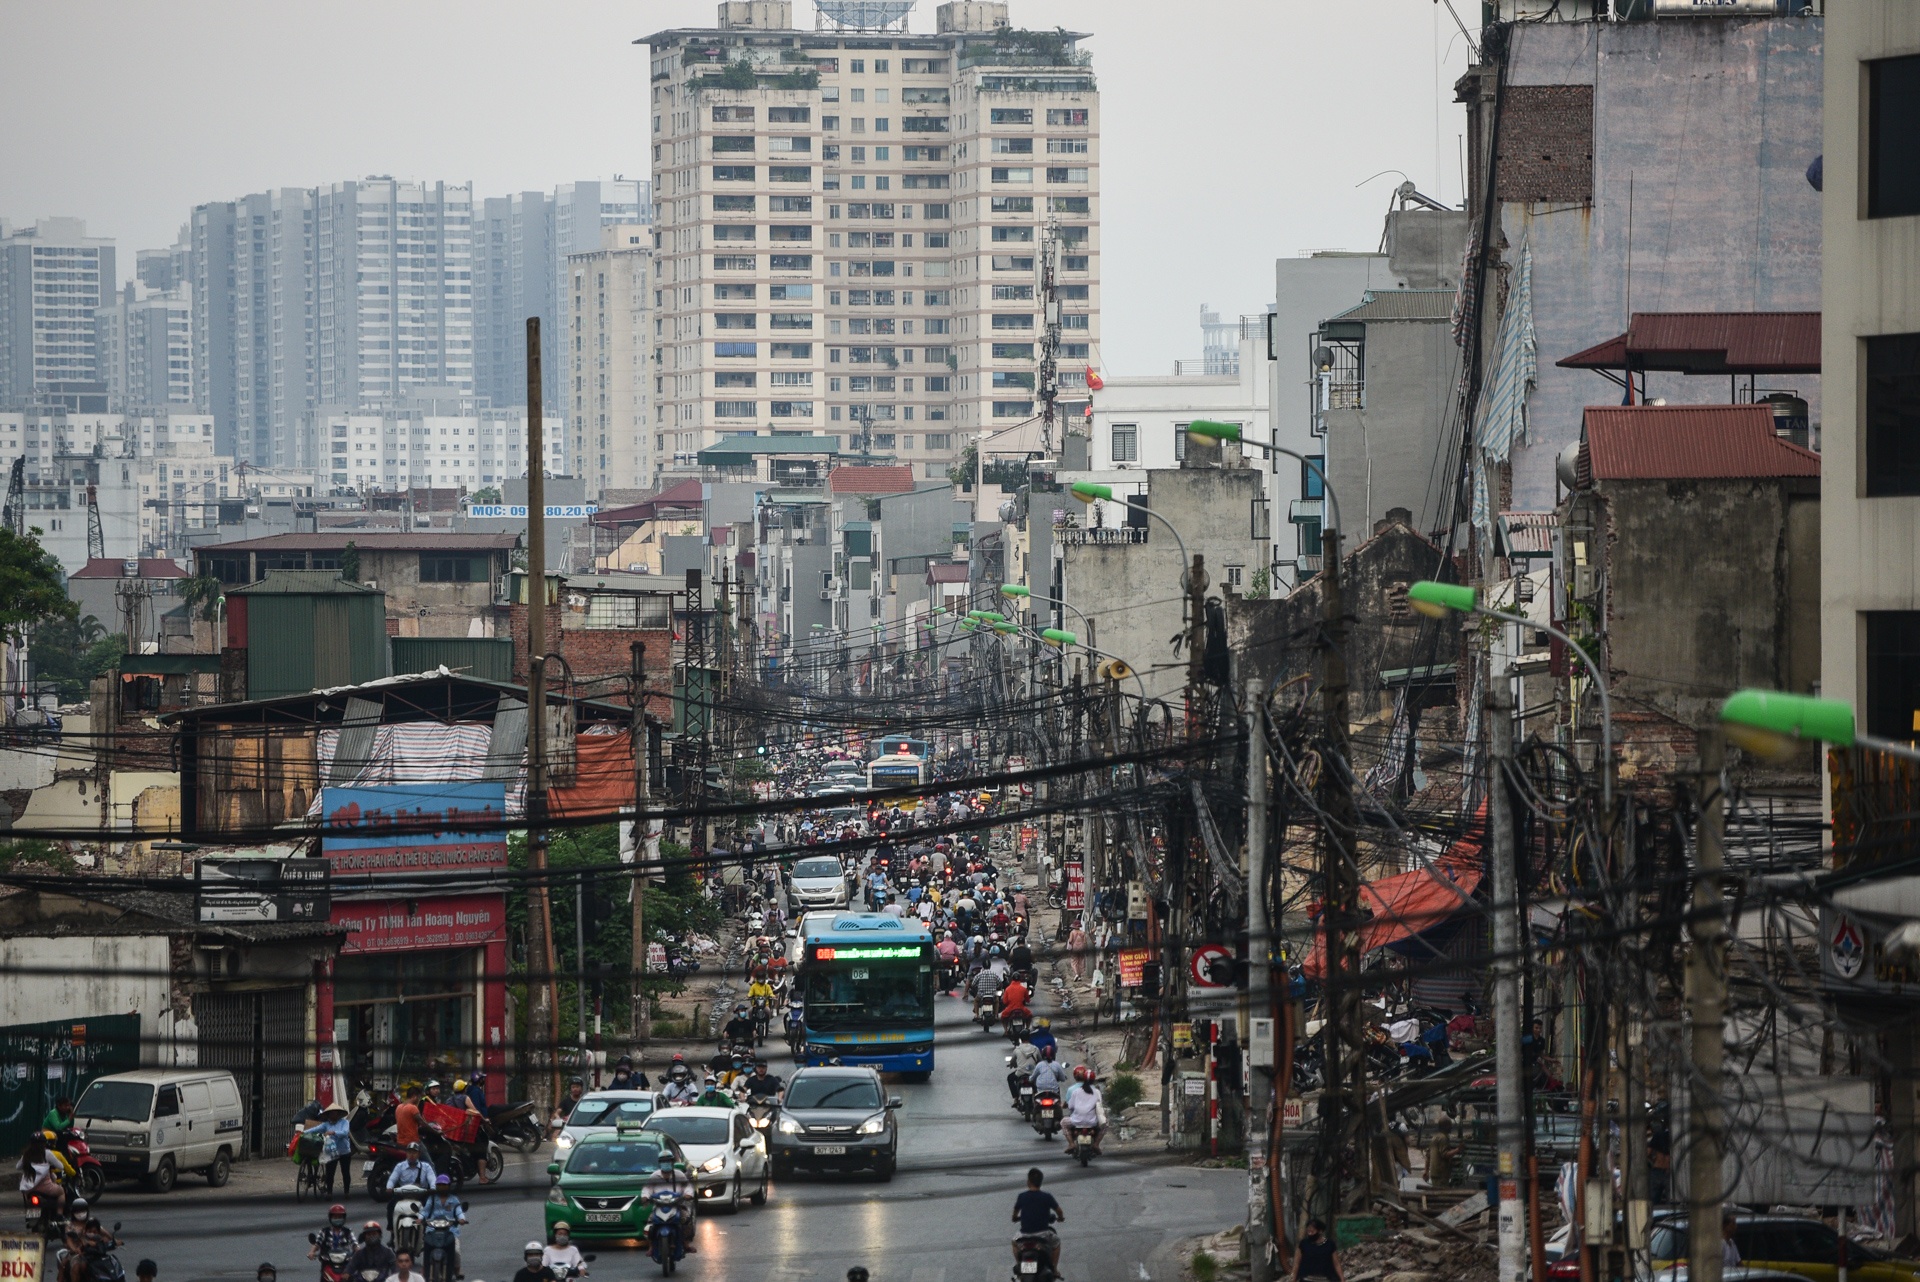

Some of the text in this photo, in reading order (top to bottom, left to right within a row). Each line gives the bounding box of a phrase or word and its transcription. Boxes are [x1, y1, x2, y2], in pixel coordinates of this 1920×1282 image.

[472, 506, 506, 516] MQC:
[365, 917, 376, 931] Ty
[379, 915, 404, 929] TNHH
[425, 911, 453, 927] Hoàng
[456, 909, 490, 926] Nguyên
[1, 1257, 35, 1278] BÚN
